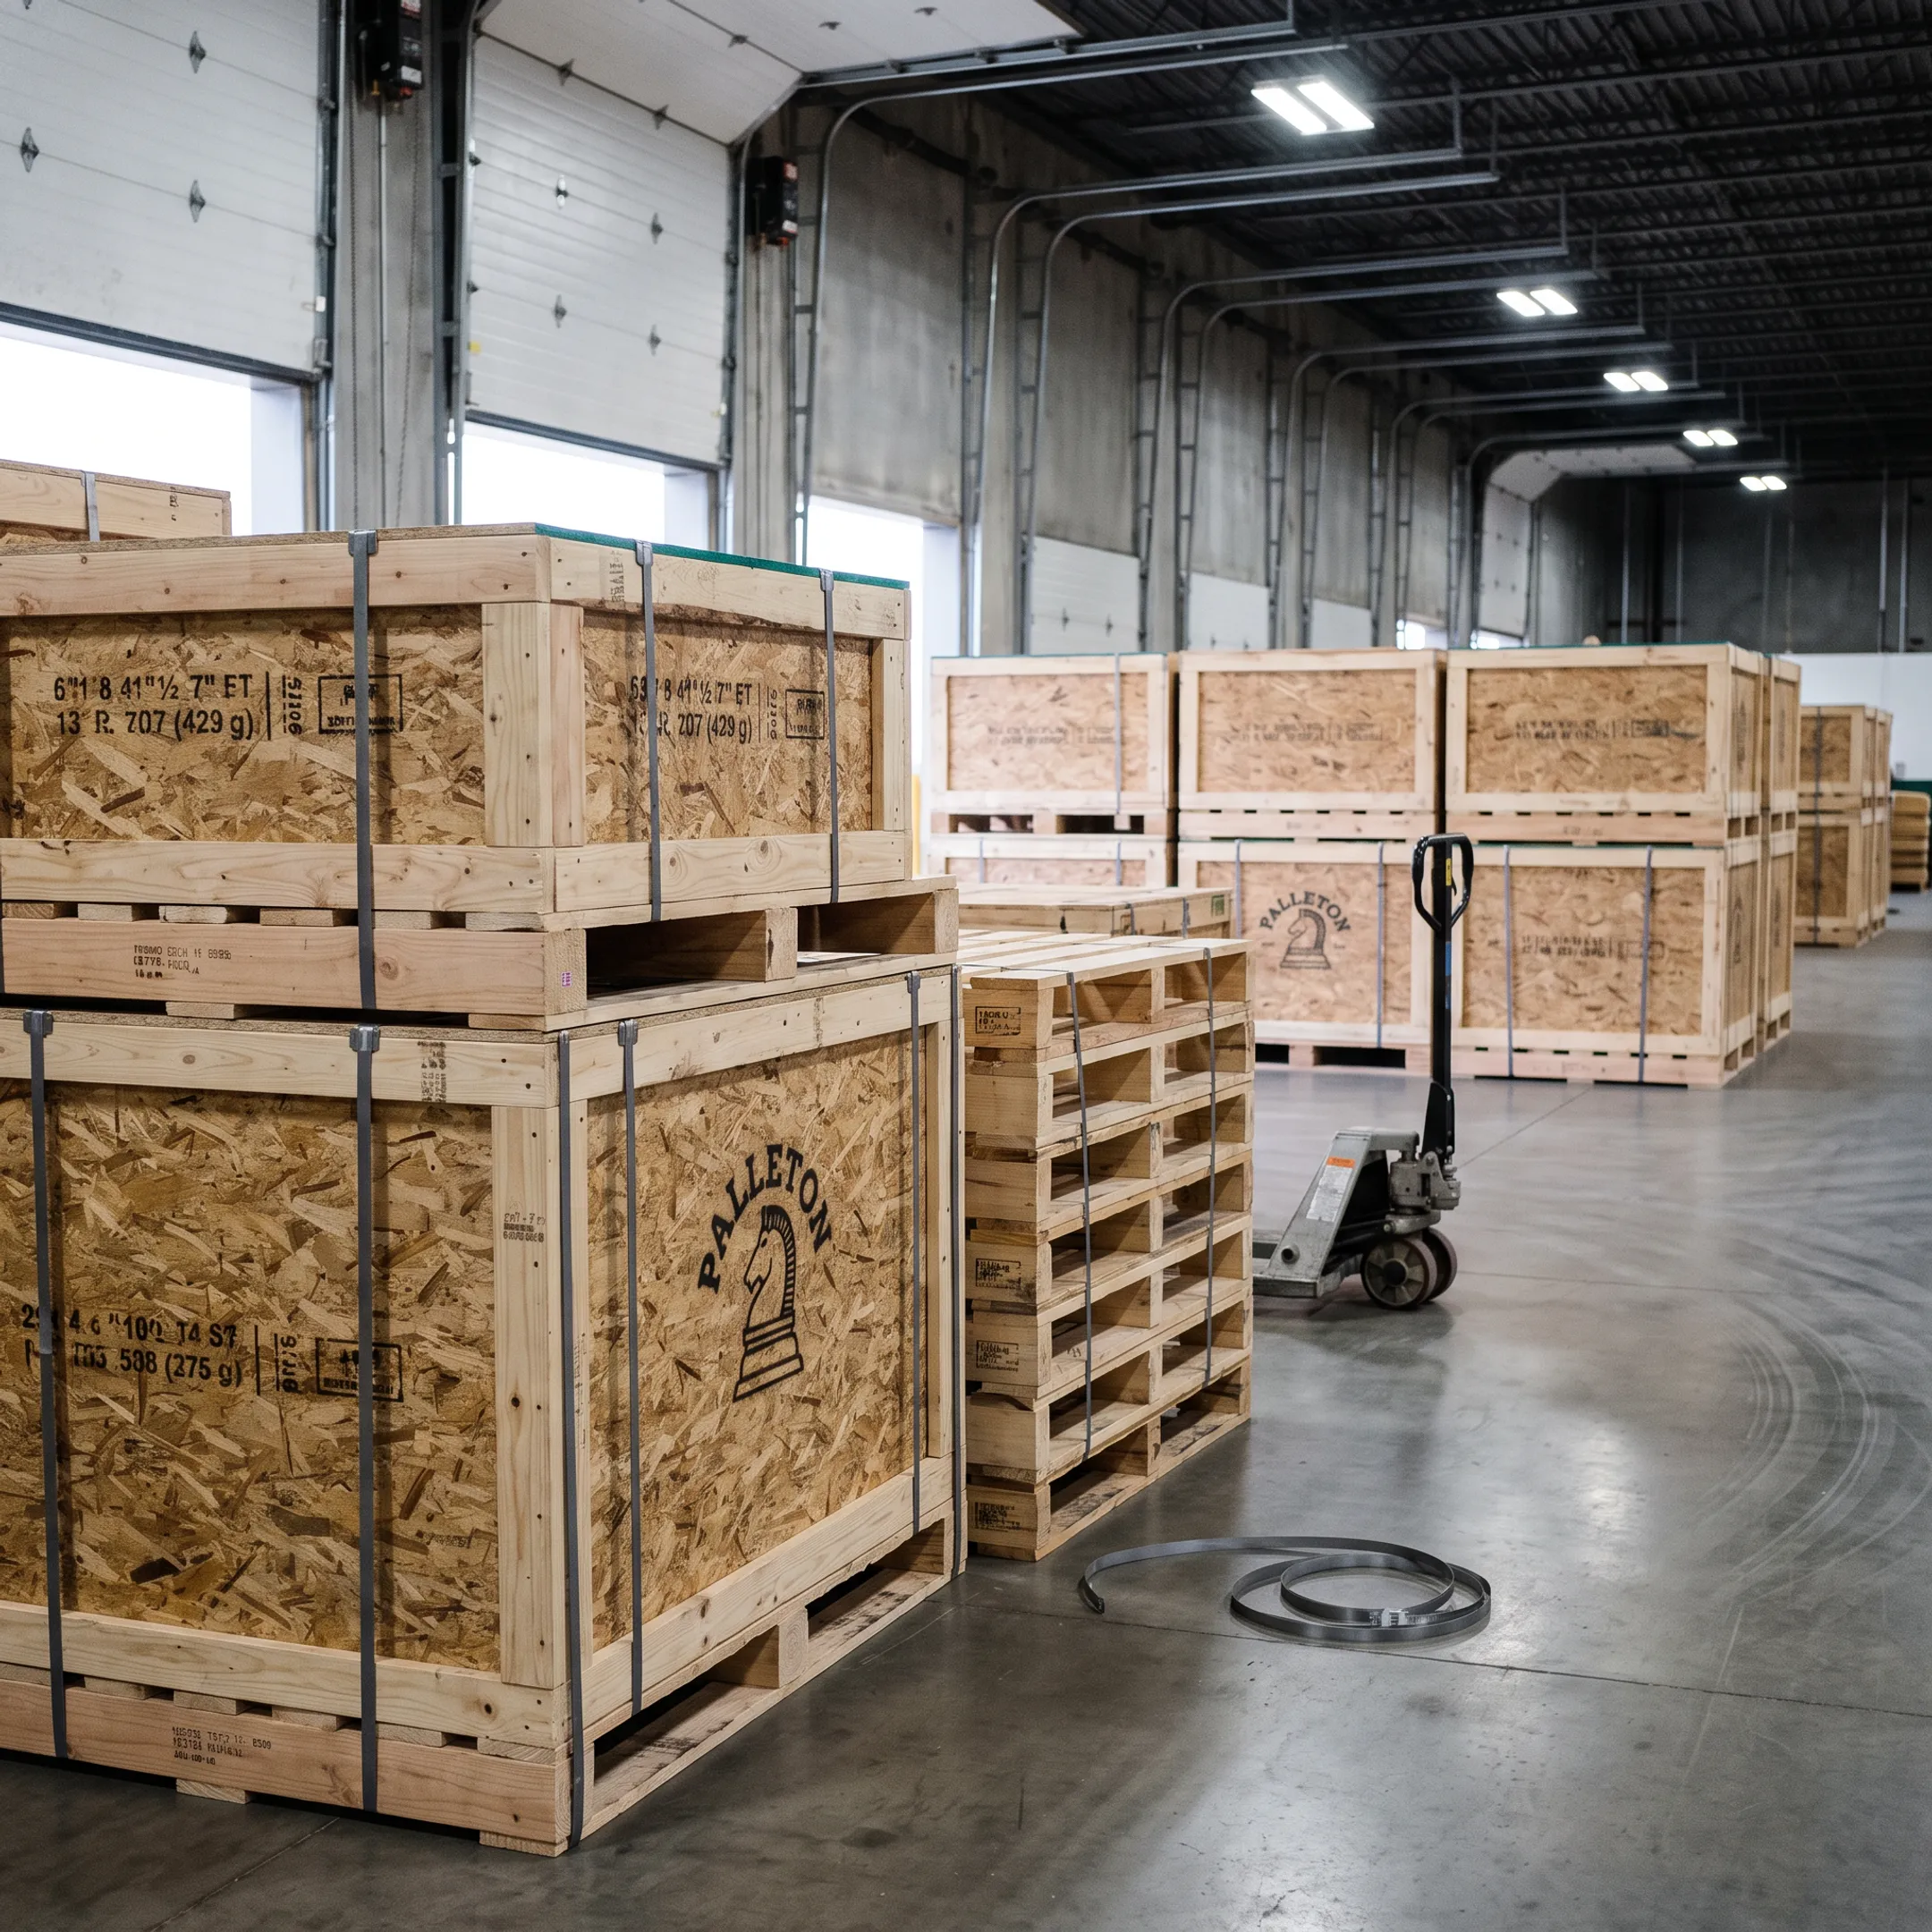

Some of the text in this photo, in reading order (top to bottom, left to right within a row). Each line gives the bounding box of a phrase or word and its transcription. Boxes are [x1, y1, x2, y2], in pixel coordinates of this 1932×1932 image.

[223, 673, 254, 699] ET
[735, 682, 753, 706] ET
[56, 709, 81, 735] 13
[1258, 890, 1352, 932] PALLETON
[697, 1143, 833, 1294] PALLETON
